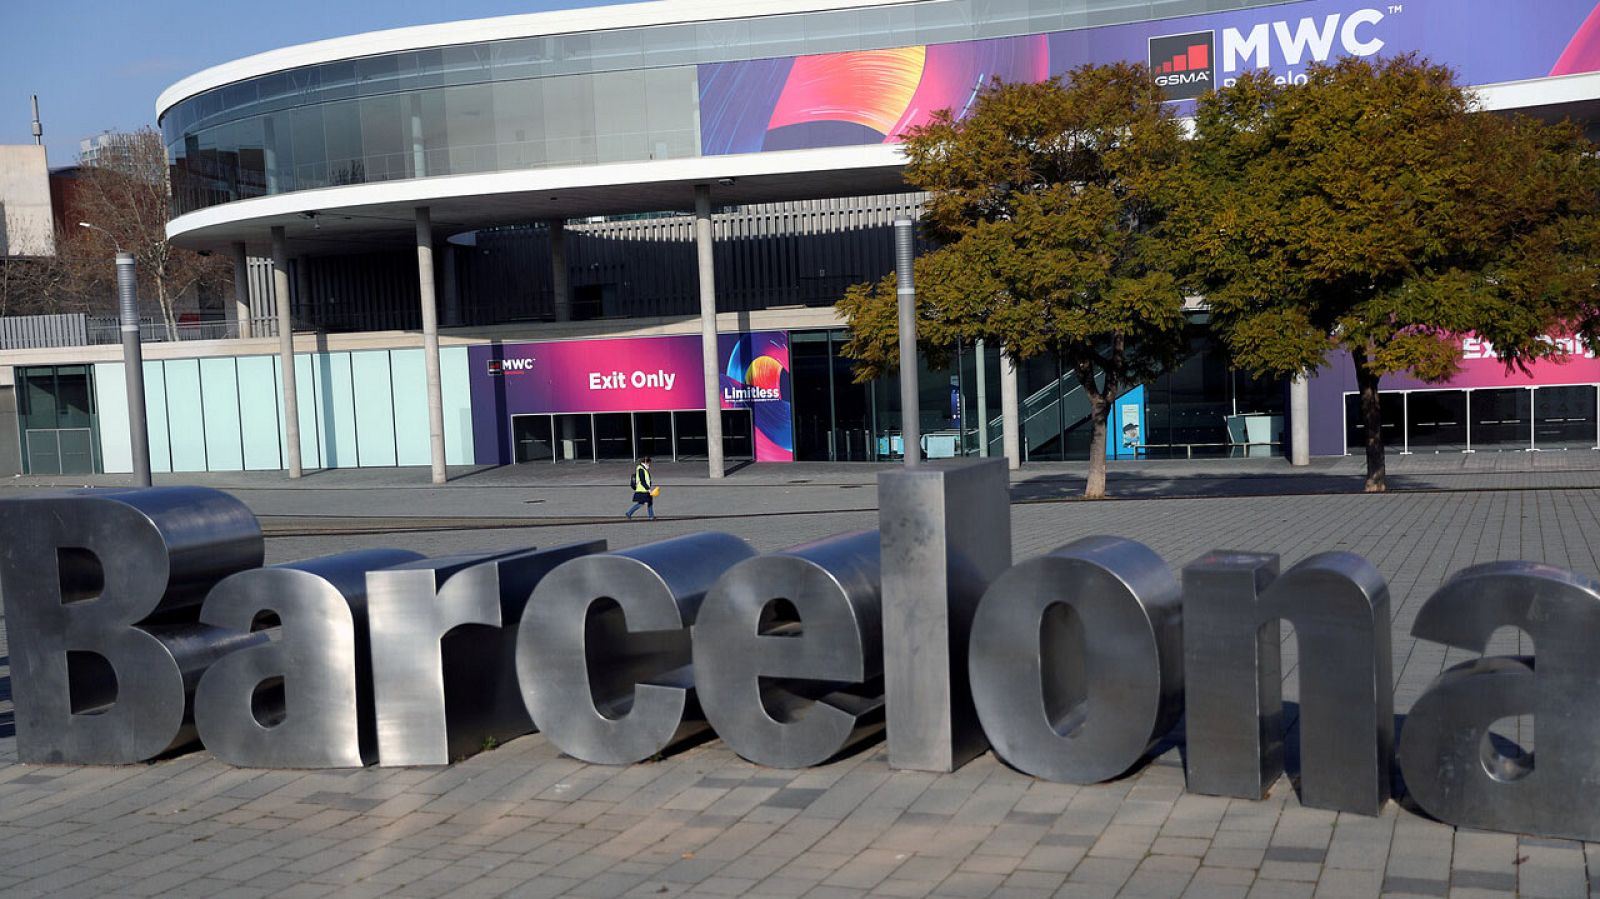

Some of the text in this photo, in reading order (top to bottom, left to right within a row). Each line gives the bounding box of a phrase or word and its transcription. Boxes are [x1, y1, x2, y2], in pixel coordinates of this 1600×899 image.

[1463, 336, 1521, 359] Ex
[589, 369, 676, 391] Exit Only
[724, 386, 780, 400] Limitless
[0, 458, 1600, 841] Barcelona
